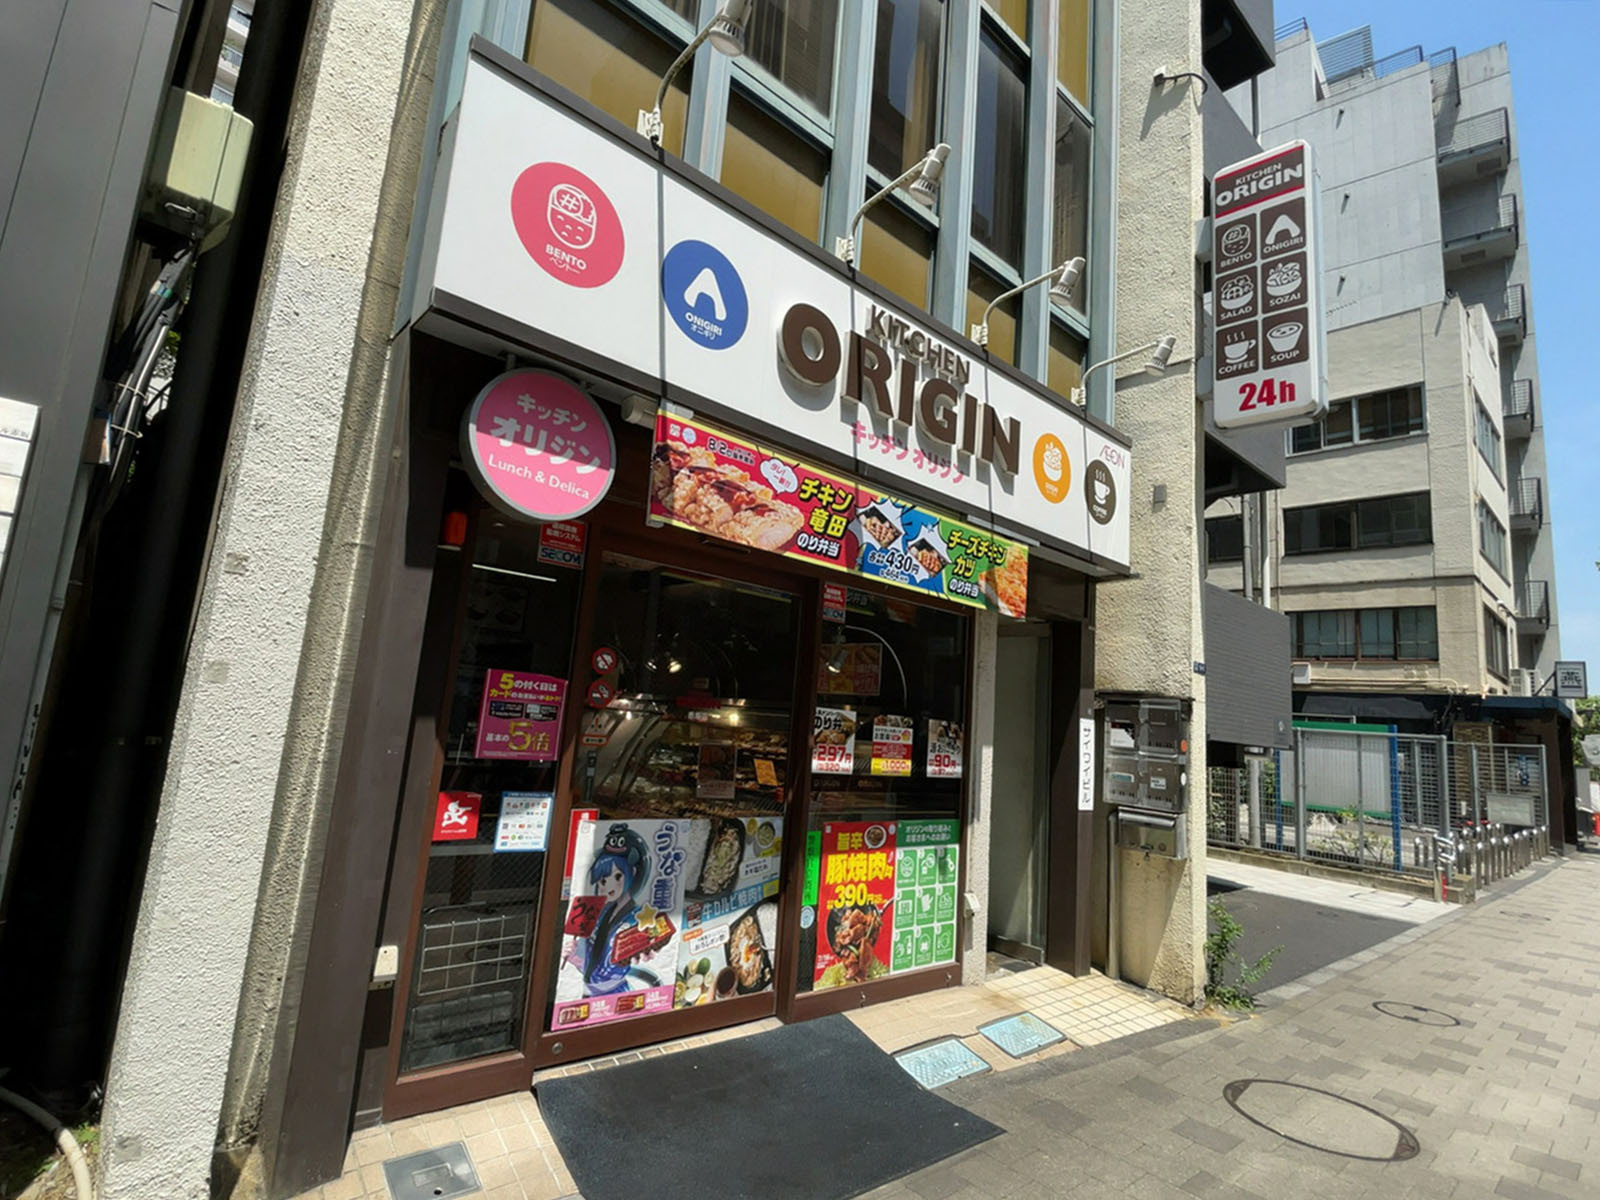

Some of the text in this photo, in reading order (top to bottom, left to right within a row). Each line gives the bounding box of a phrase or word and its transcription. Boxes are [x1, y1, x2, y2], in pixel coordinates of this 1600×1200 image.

[1216, 163, 1303, 207] ORIGIN
[1235, 162, 1282, 186] KITCHEN
[545, 244, 587, 270] BENTO
[1263, 236, 1304, 254] ONIGIRI
[1220, 252, 1253, 268] BENTO
[1220, 305, 1253, 321] SALAD
[1269, 292, 1301, 308] SOZAI
[685, 312, 723, 337] ONIGIRI
[867, 304, 971, 385] KITCHEN
[1270, 349, 1301, 364] SOUP
[1218, 359, 1256, 375] COFFEE
[777, 302, 1021, 477] ORIGIN
[1238, 378, 1296, 413] 24h
[516, 393, 588, 432] キッチン
[490, 415, 602, 475] オリジン
[849, 420, 967, 484] キッチン オリジン
[487, 453, 591, 501] Lunch & Delica
[798, 477, 855, 513] チキン
[808, 507, 848, 538] 竜田
[540, 547, 582, 565] SECOM
[797, 532, 841, 560] のり弁当
[948, 530, 1008, 565] チーズチキン
[952, 555, 977, 579] カツ
[949, 578, 979, 598] のり弁当
[837, 832, 863, 851] 旨辛
[652, 824, 684, 910] うな重
